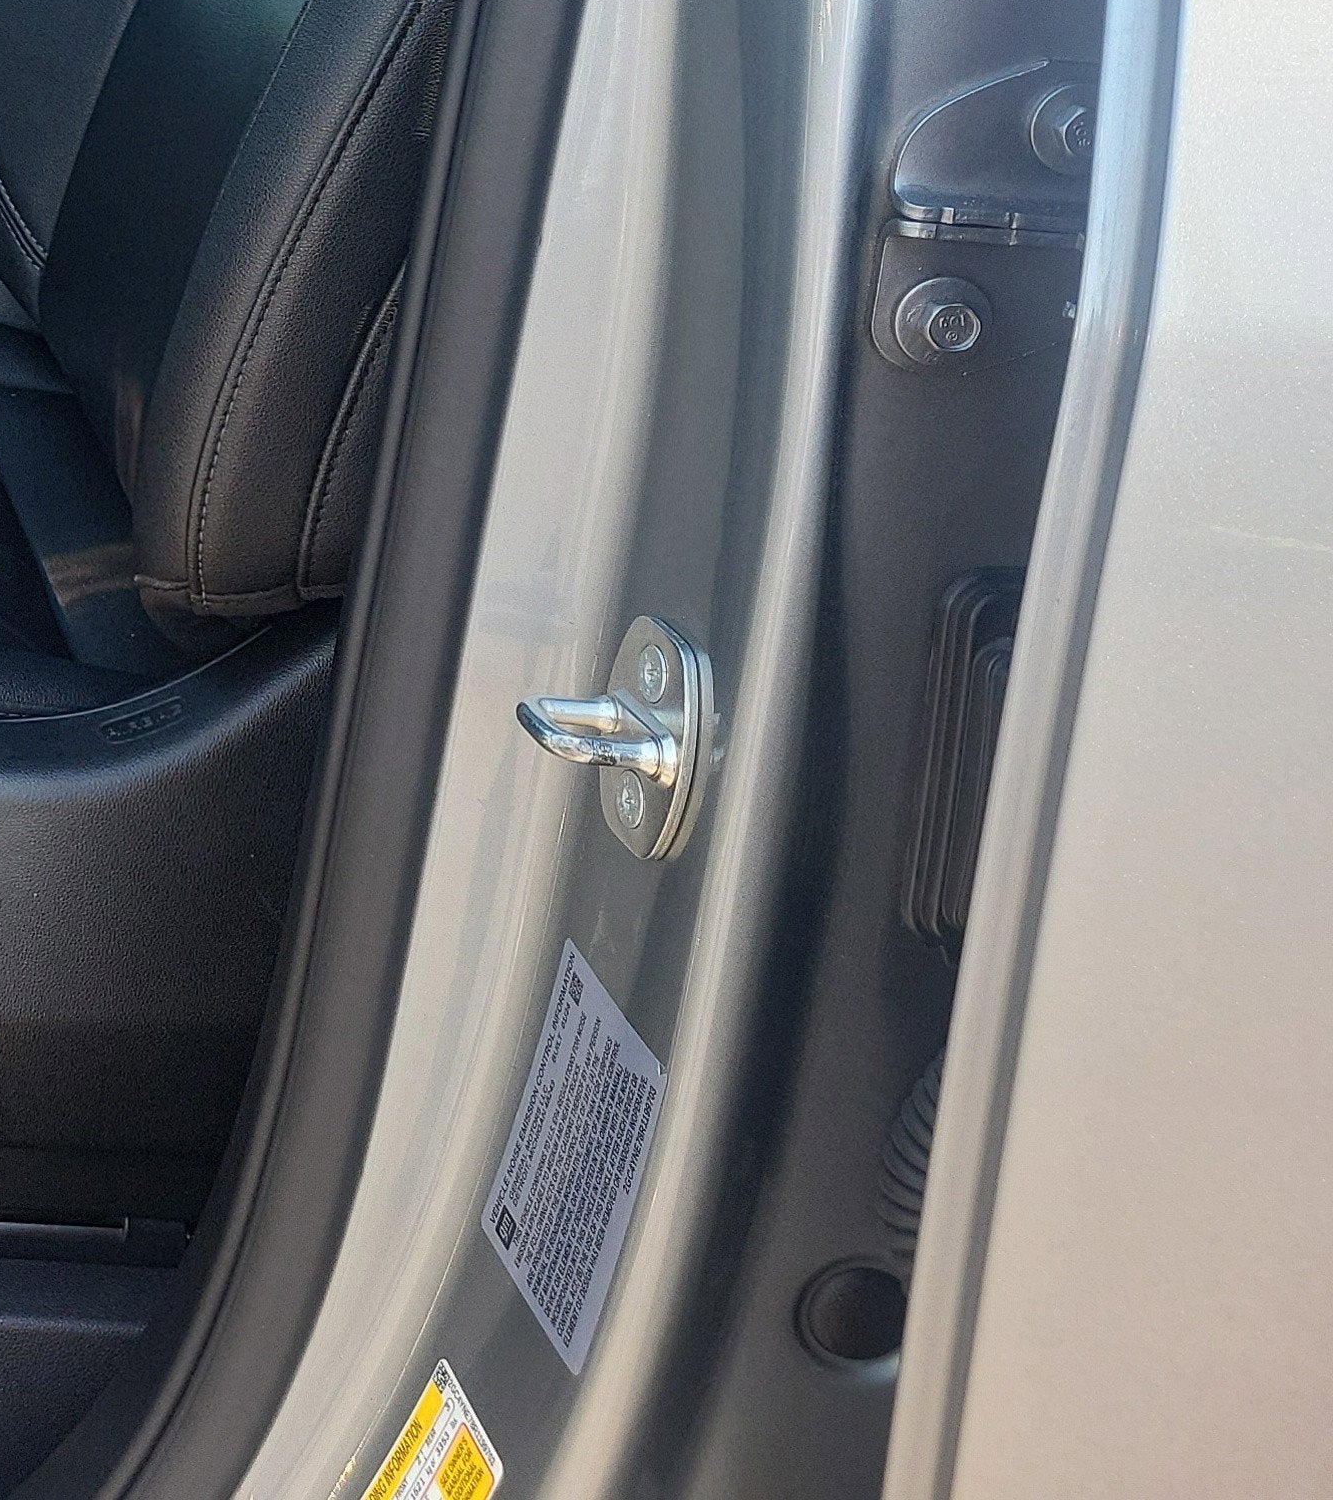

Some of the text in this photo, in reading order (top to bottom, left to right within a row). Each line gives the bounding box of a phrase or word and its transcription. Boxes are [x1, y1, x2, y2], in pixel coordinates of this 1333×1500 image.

[551, 1033, 562, 1064] BUILT
[490, 951, 576, 1226] VEHICLE NOISE EMISSION CONTROL INFORMATION
[525, 1106, 541, 1151] MOTORS
[528, 1108, 547, 1161] MICHIGAN
[382, 1416, 422, 1486] INFORMATION
